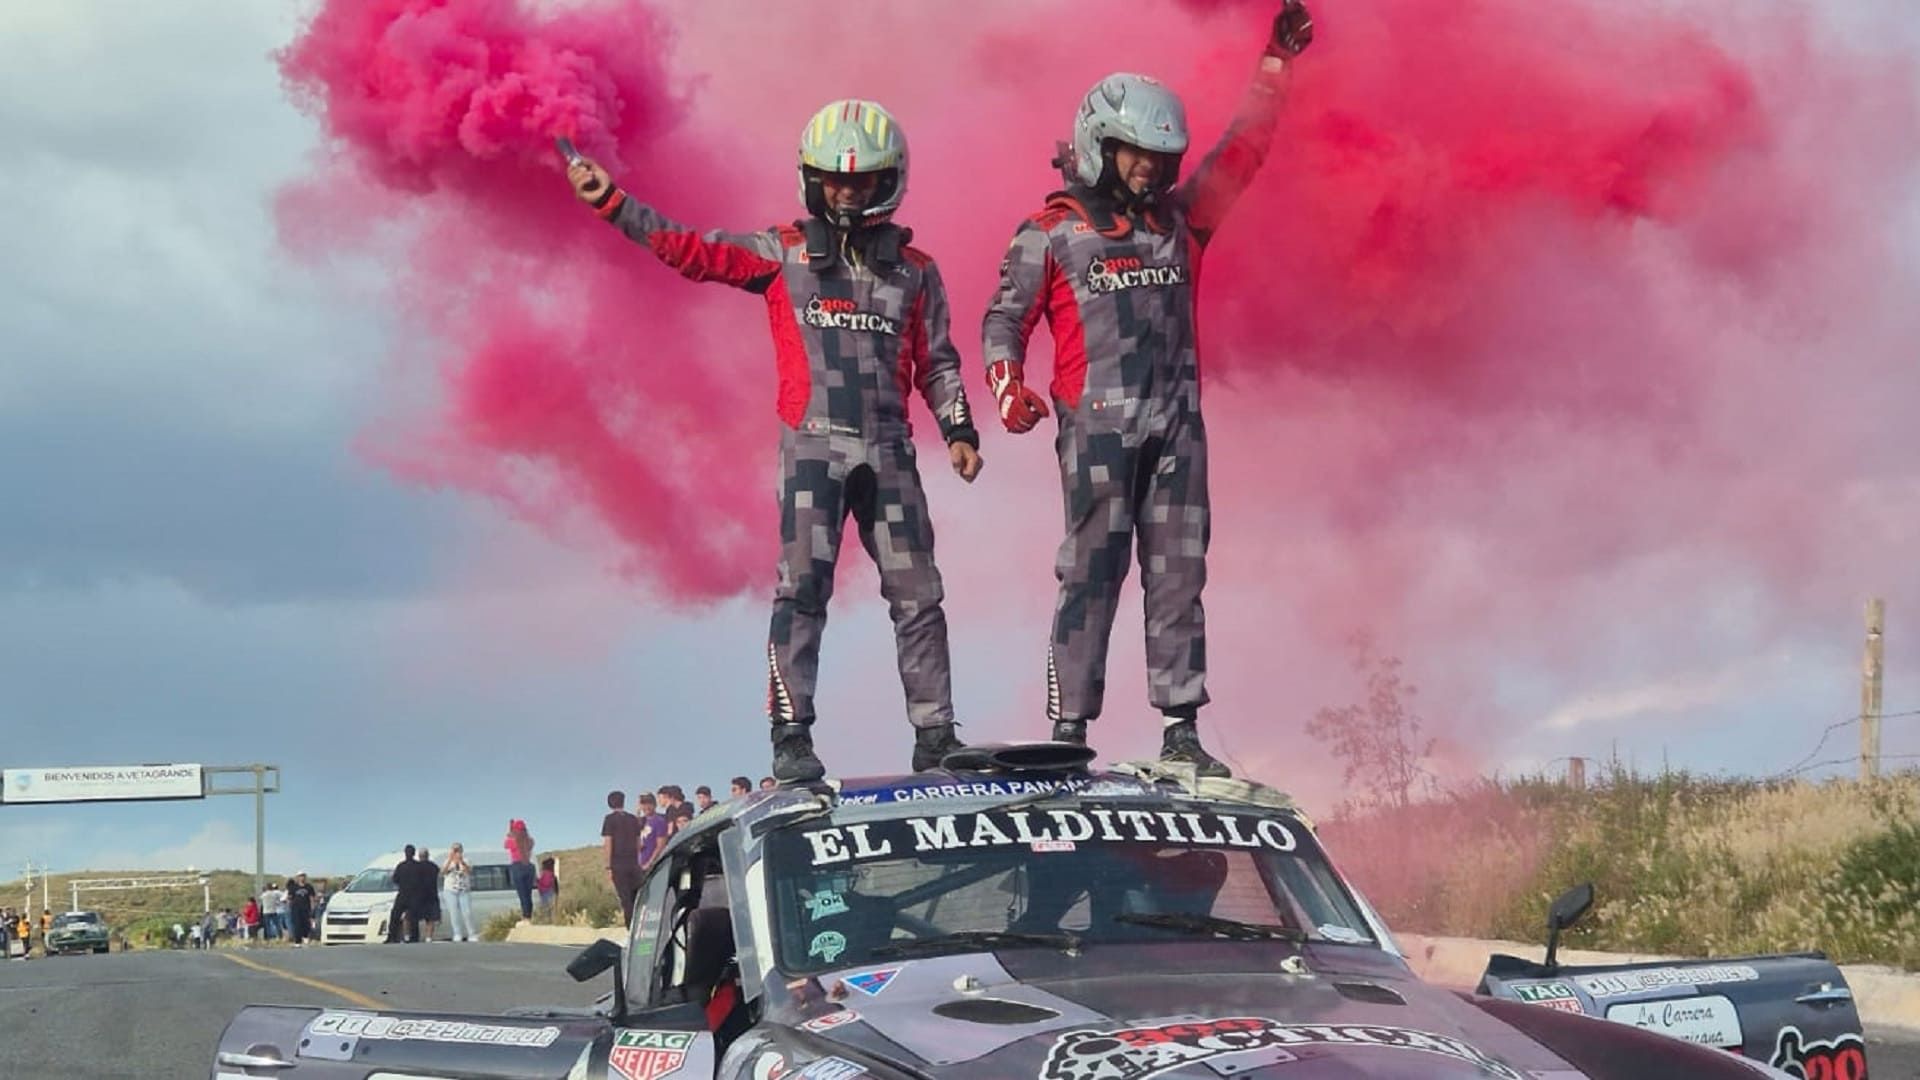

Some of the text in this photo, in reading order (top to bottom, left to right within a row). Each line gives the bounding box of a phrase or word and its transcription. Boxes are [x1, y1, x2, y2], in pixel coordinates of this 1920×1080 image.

[44, 767, 194, 782] BIENVENIDOS A VETAGRANDE
[893, 781, 1005, 802] CARRERA
[802, 808, 1297, 866] EL MALDITILLO
[1517, 984, 1571, 999] TAG
[1635, 1003, 1715, 1028] La Carrera
[625, 1031, 689, 1049] TAG
[613, 1049, 680, 1080] HEUER
